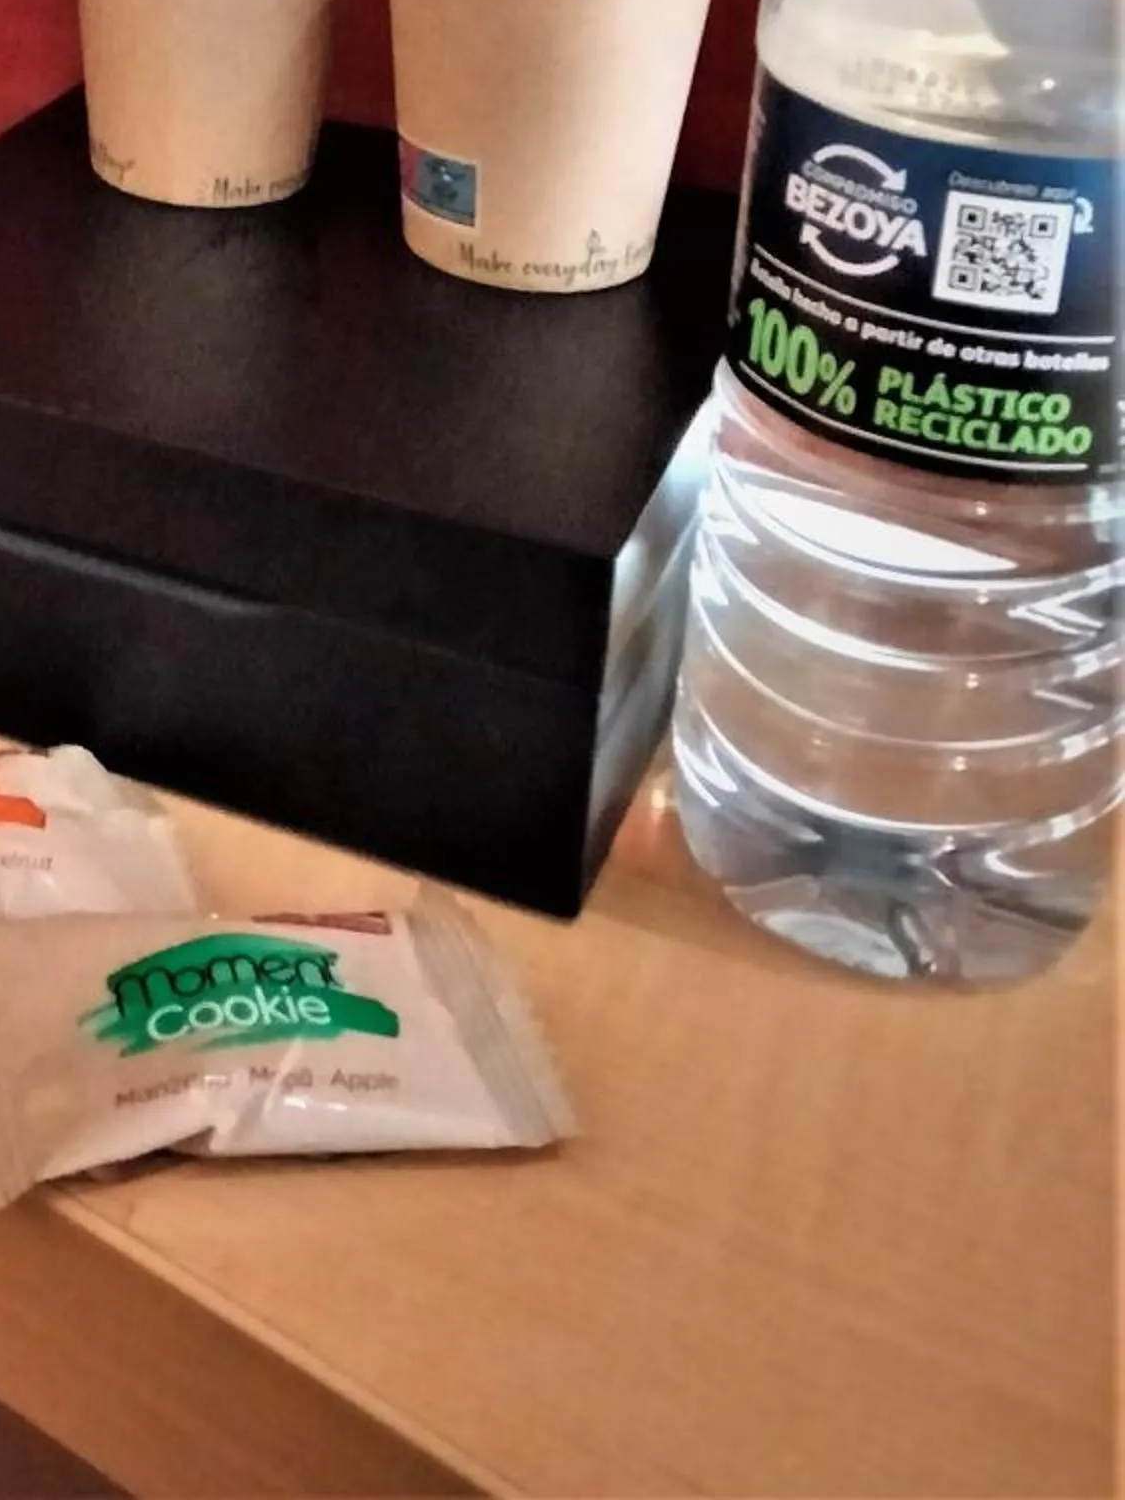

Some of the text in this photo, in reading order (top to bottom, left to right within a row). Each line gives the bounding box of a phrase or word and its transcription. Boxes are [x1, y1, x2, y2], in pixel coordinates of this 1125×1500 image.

[785, 172, 928, 257] BEZOYA
[748, 298, 857, 415] 100%
[878, 366, 1072, 423] PLÁSTICO
[860, 321, 924, 350] partir
[926, 337, 957, 358] de
[959, 346, 1021, 368] otras
[873, 397, 1093, 455] RECICLADO
[330, 1067, 401, 1093] Apple
